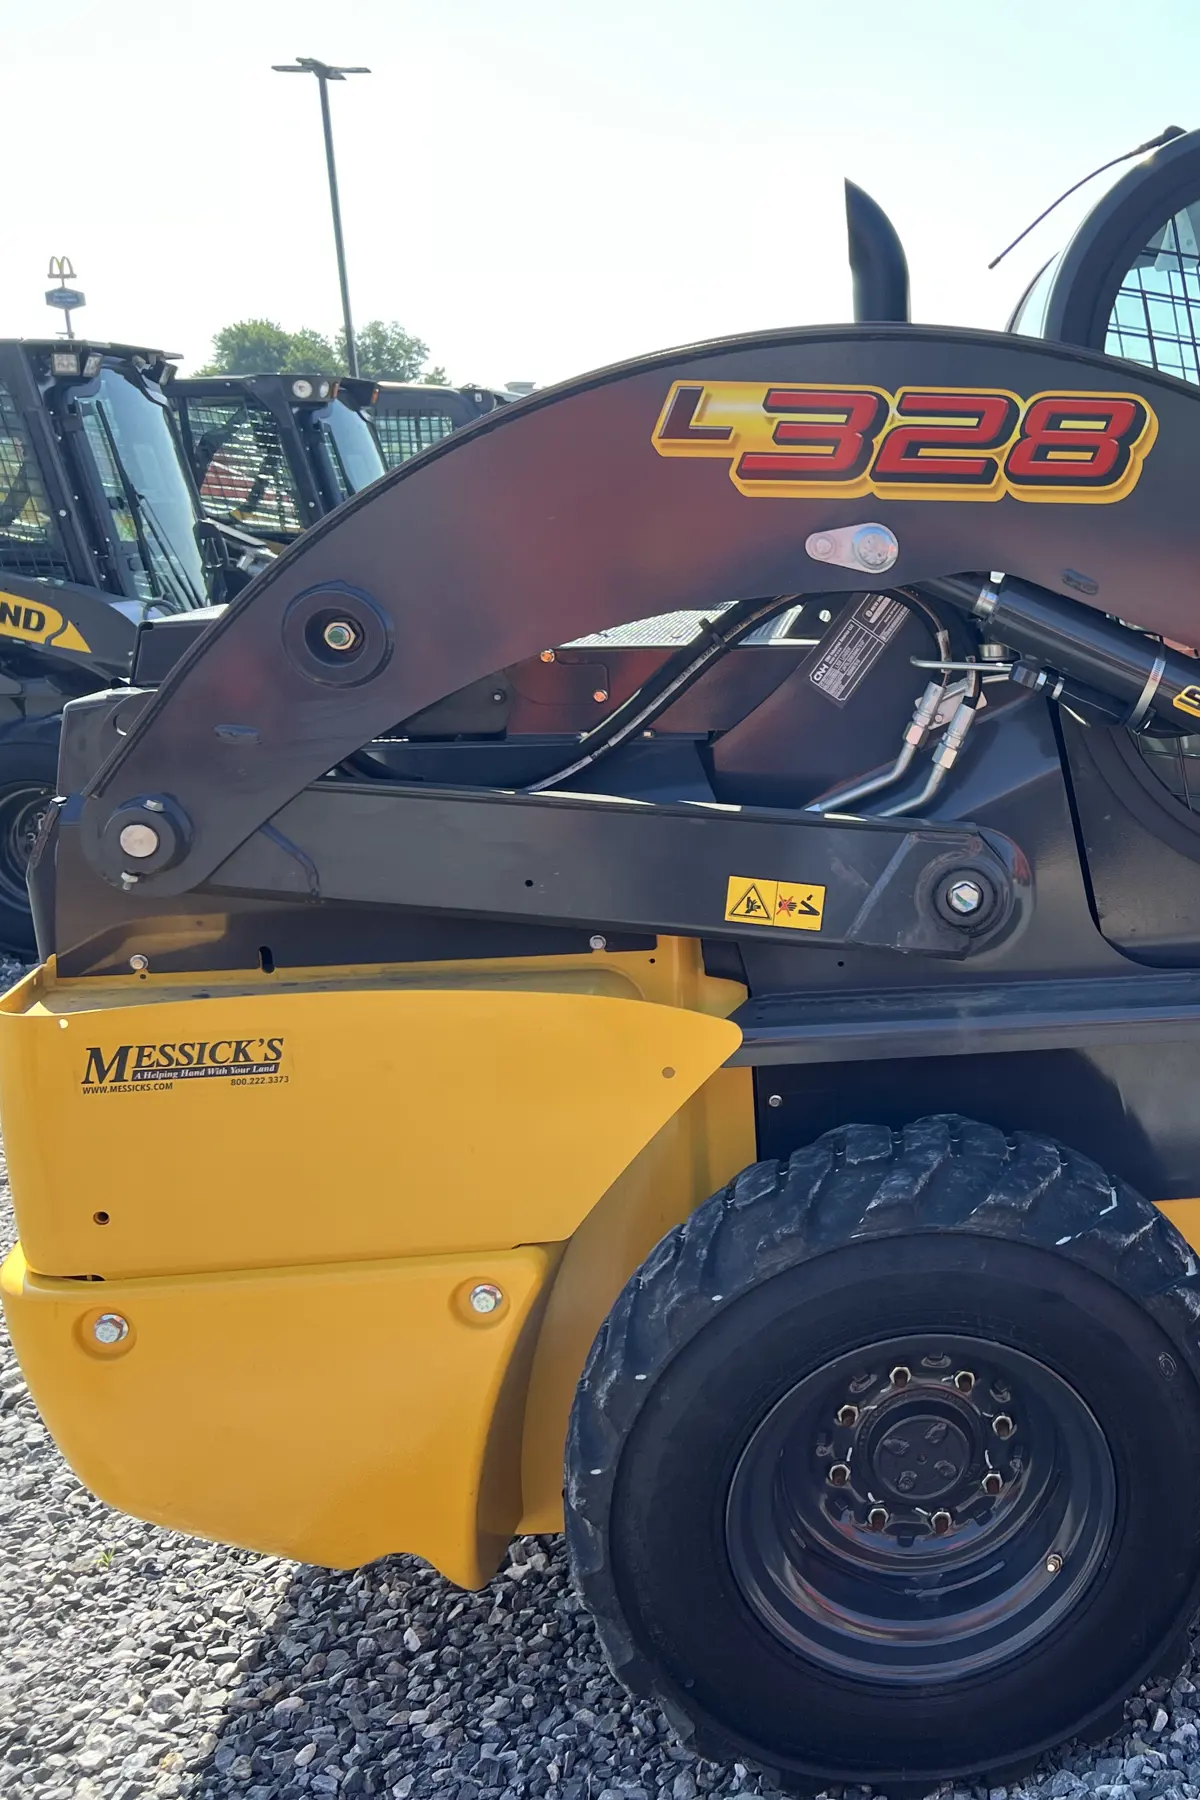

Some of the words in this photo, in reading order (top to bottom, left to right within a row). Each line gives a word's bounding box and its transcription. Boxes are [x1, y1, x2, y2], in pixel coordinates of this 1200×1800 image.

[653, 382, 1155, 500] L328
[813, 663, 829, 681] CNH
[134, 1072, 142, 1080] A
[143, 1070, 178, 1080] Helping
[180, 1068, 205, 1077] Hand
[207, 1066, 228, 1076] With
[231, 1066, 250, 1075] Your
[252, 1064, 275, 1073] Land
[82, 1082, 173, 1095] WWW.MESSICKS.COM
[230, 1076, 289, 1086] 800.222.3373
